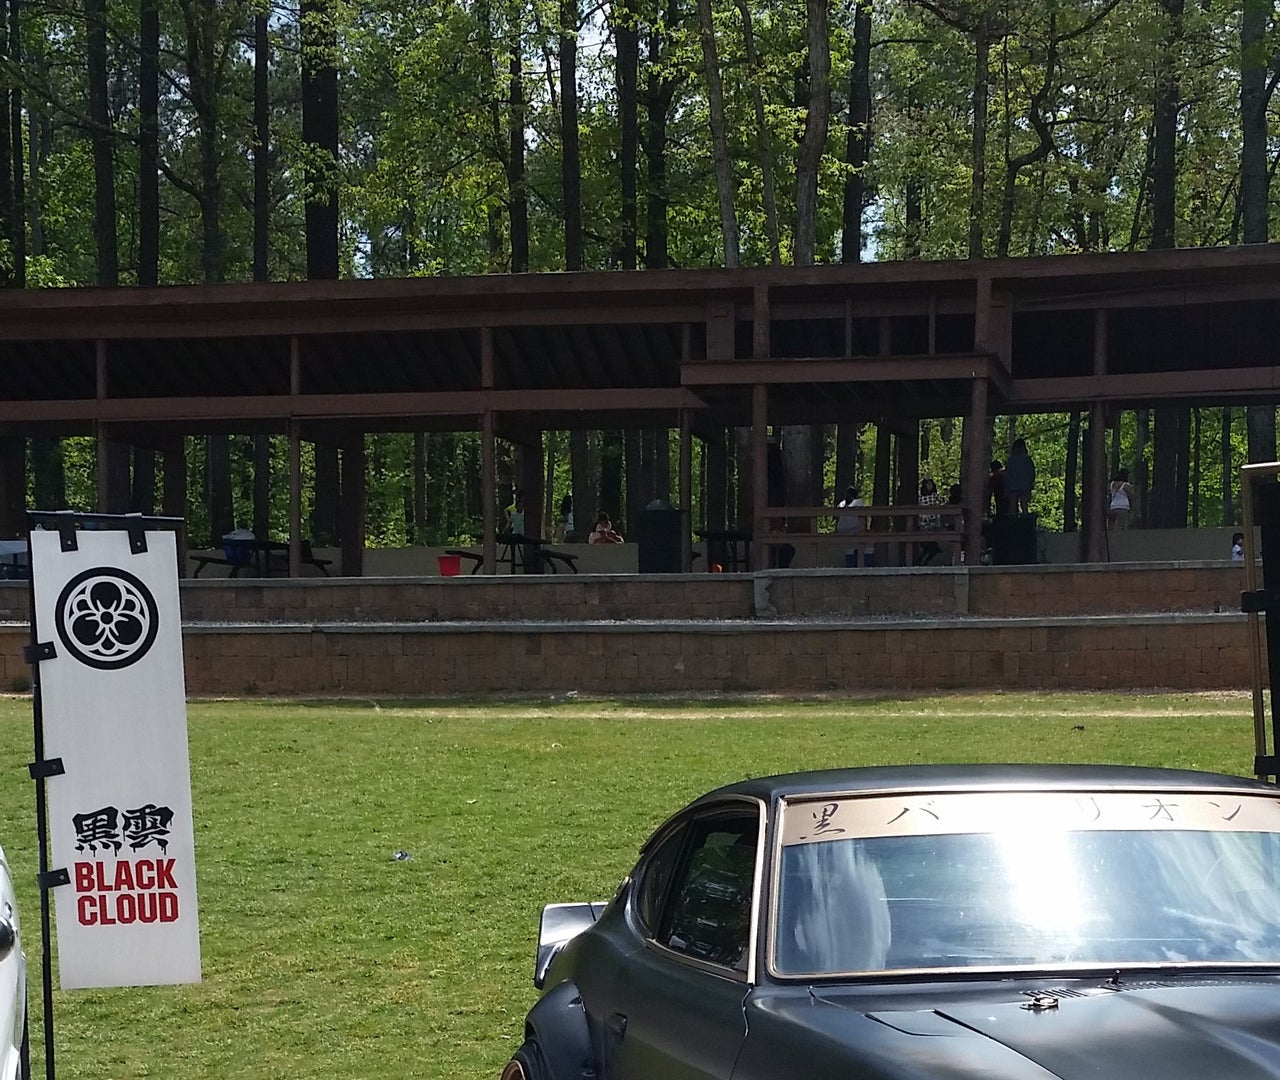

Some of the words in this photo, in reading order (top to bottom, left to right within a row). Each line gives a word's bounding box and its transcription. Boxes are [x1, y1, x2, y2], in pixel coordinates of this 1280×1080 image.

[72, 804, 175, 857] 黒雲
[74, 858, 178, 893] BLACK
[77, 892, 179, 926] CLOUD
